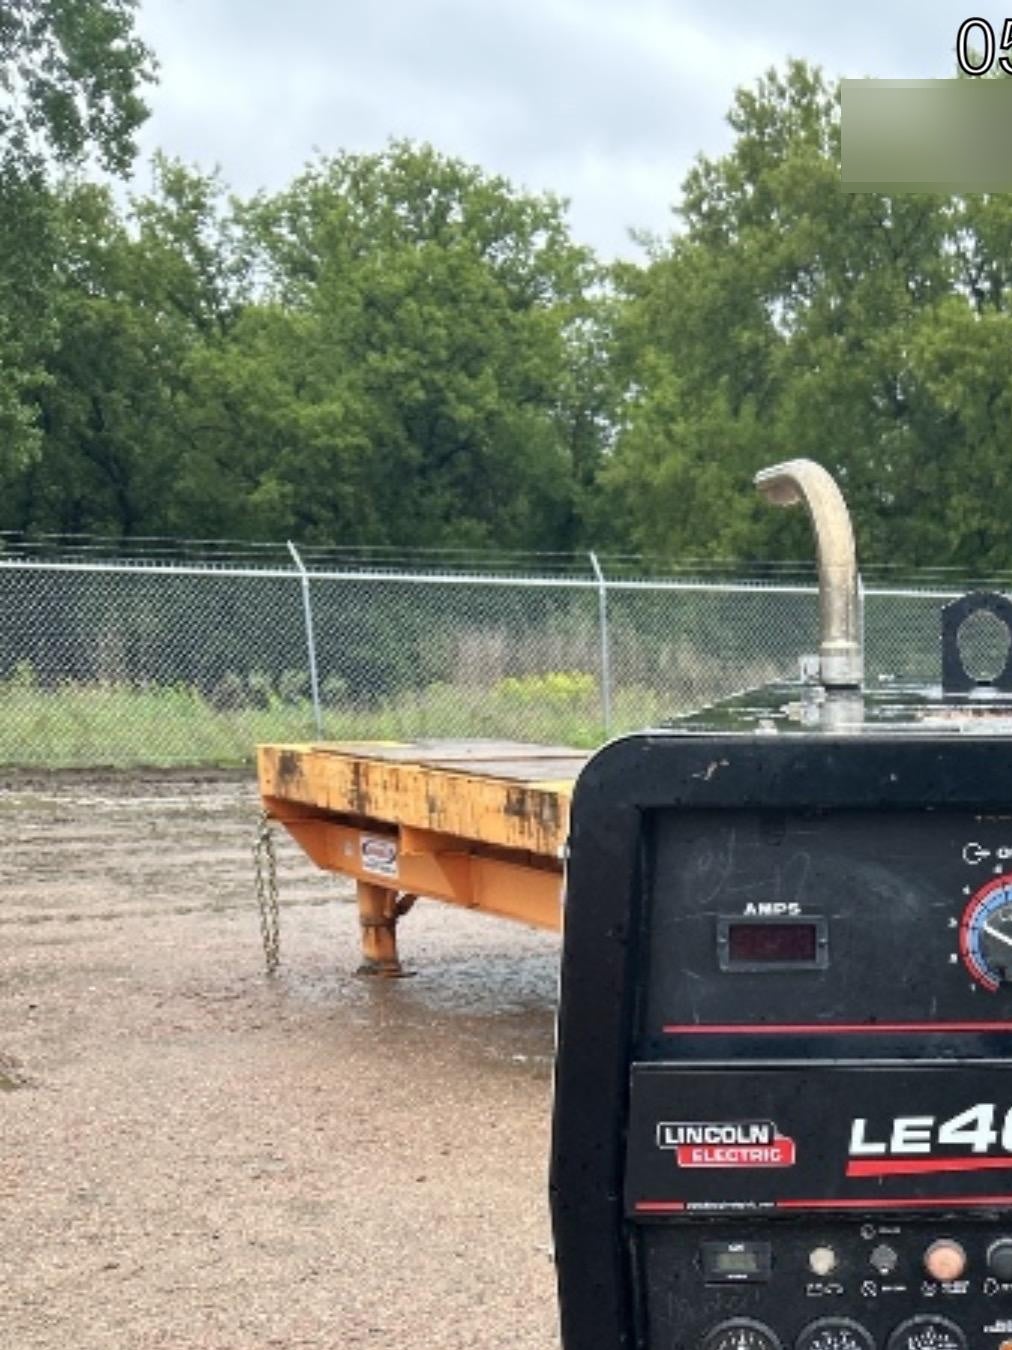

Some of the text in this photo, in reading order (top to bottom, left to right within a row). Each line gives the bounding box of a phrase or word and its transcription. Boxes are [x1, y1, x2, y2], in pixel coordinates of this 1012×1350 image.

[743, 902, 801, 916] AMPS
[665, 1124, 769, 1145] LINCOLN
[691, 1148, 783, 1163] ELECTRIC
